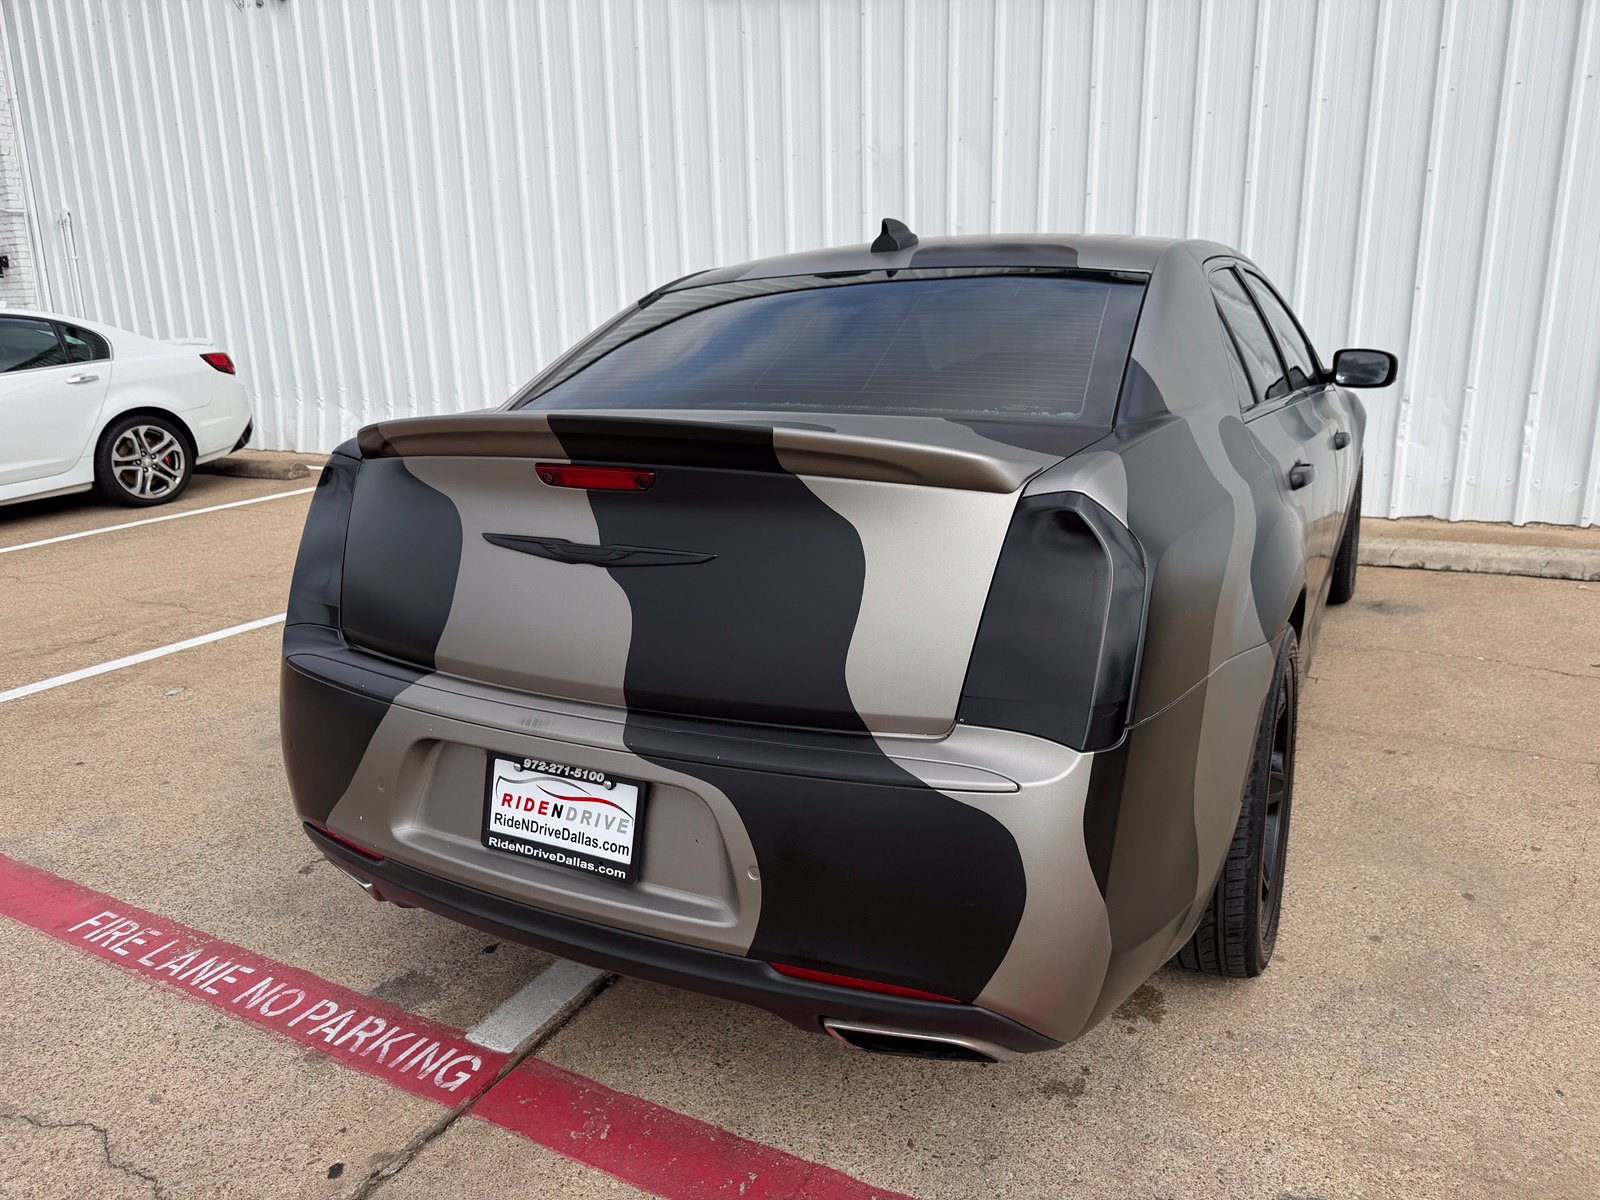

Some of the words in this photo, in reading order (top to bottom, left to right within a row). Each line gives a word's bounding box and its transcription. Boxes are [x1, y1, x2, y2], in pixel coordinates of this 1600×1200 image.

[523, 758, 605, 783] 972-271-5100
[494, 812, 630, 856] RideNDriveDallas.com
[501, 792, 630, 835] RIDENDRIVE
[488, 836, 626, 879] RideNDriveDallas.com
[67, 910, 162, 956] FIRE
[137, 940, 254, 995] LANE
[232, 976, 306, 1018] NO
[286, 998, 481, 1092] PARKING
